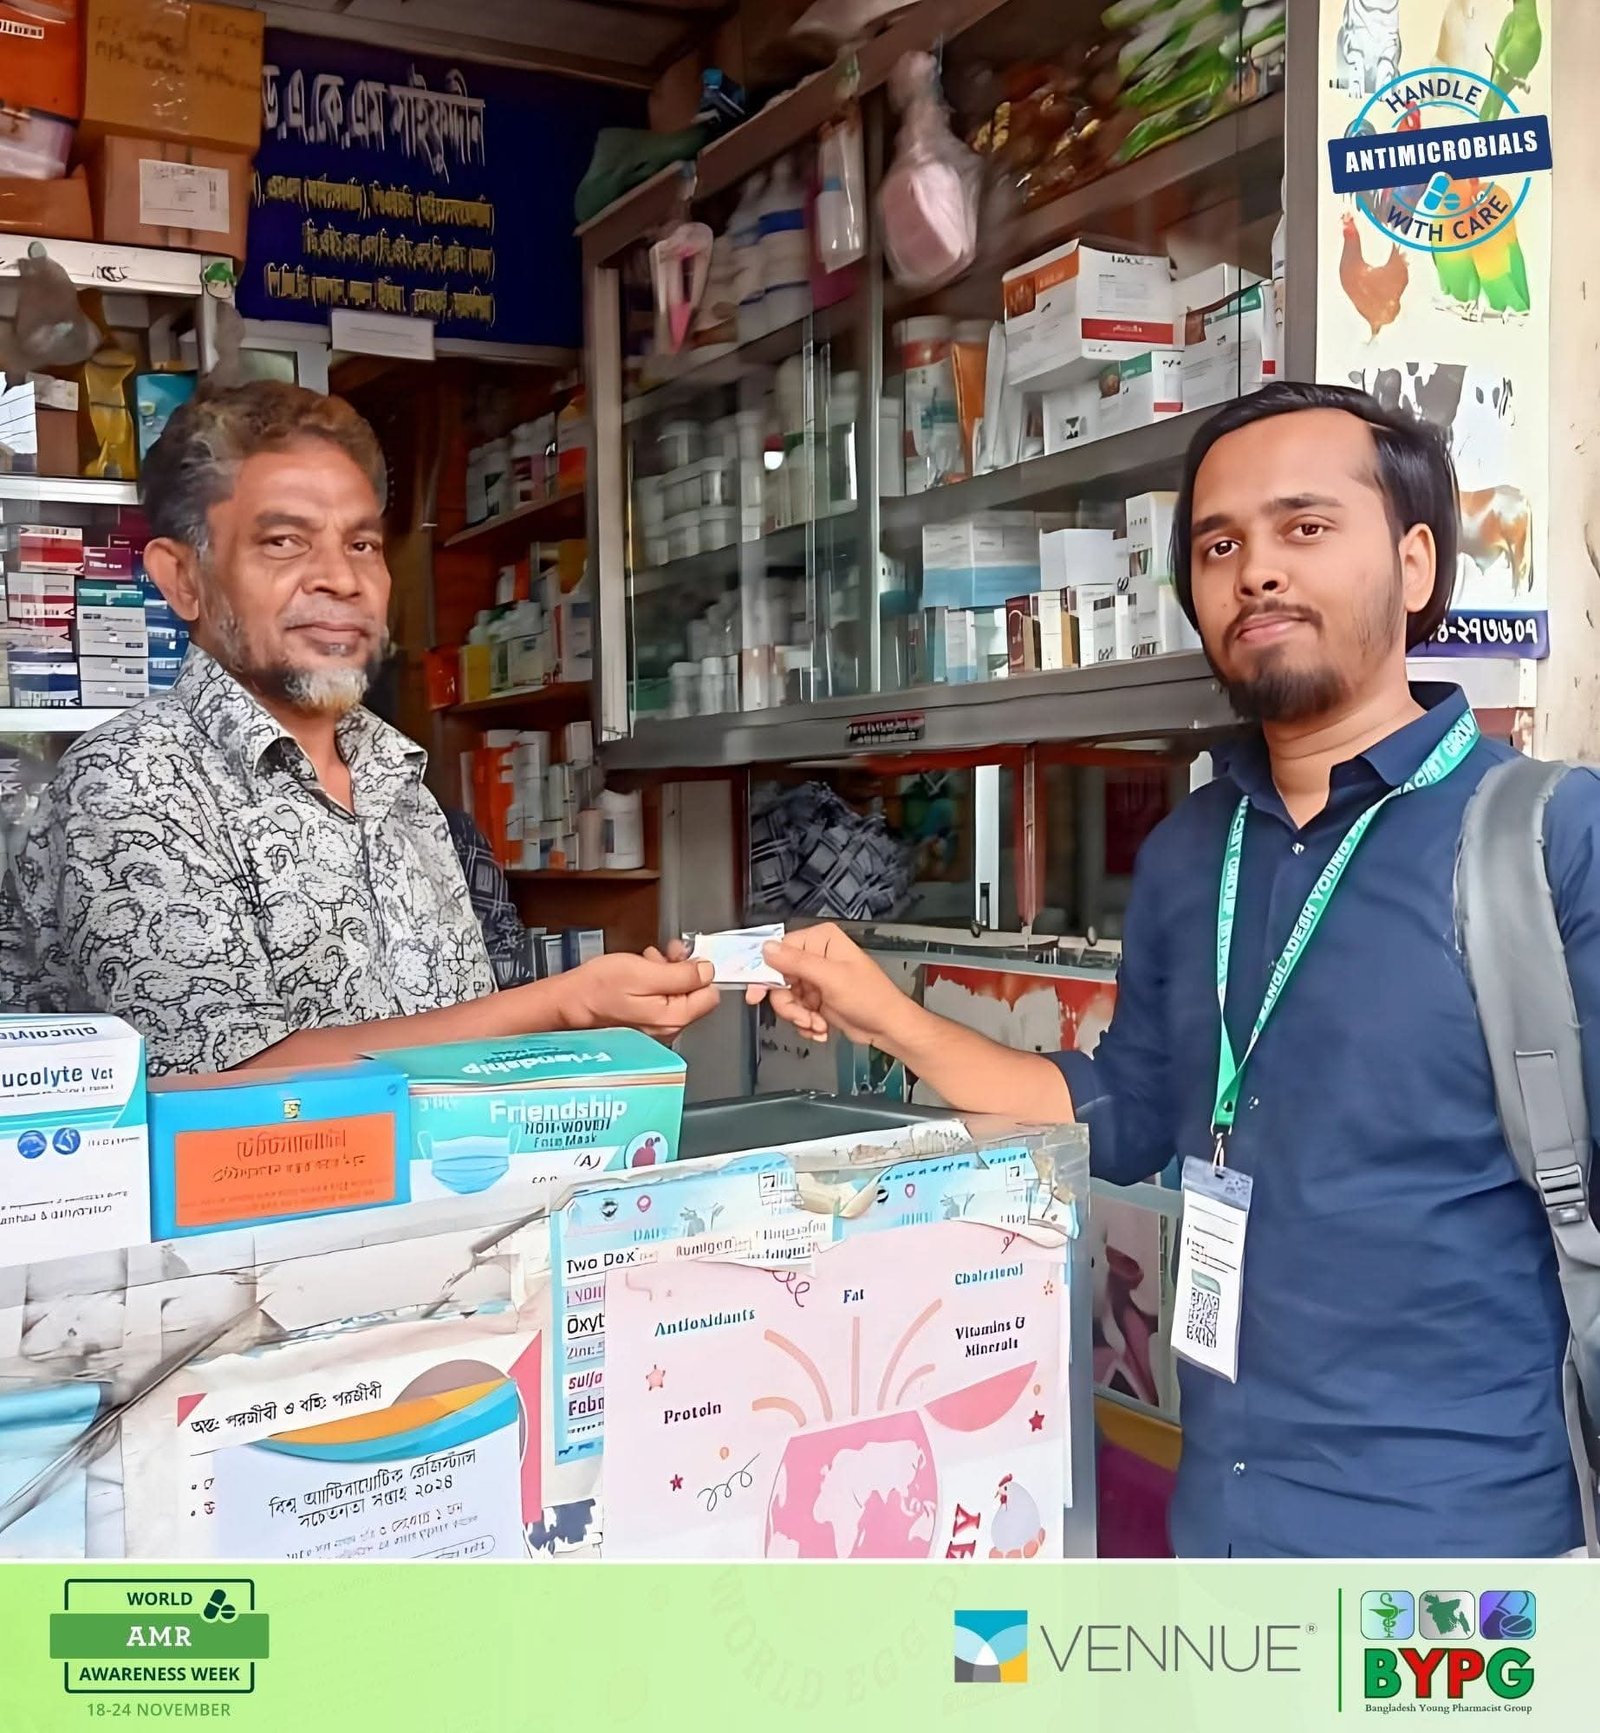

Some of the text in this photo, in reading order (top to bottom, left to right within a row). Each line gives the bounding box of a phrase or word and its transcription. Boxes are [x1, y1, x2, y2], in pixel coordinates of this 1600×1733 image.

[1311, 842, 1351, 901] YOUNG
[490, 1094, 627, 1124] Friendship
[567, 1259, 597, 1274] Two
[843, 1289, 864, 1303] Fat
[654, 1309, 756, 1337] Antioxidants
[956, 1320, 1011, 1340] Vitamins
[965, 1338, 1018, 1358] Minerals
[284, 1402, 295, 1415] ও
[664, 1401, 722, 1425] Protein
[414, 1474, 454, 1497] ২০২৪
